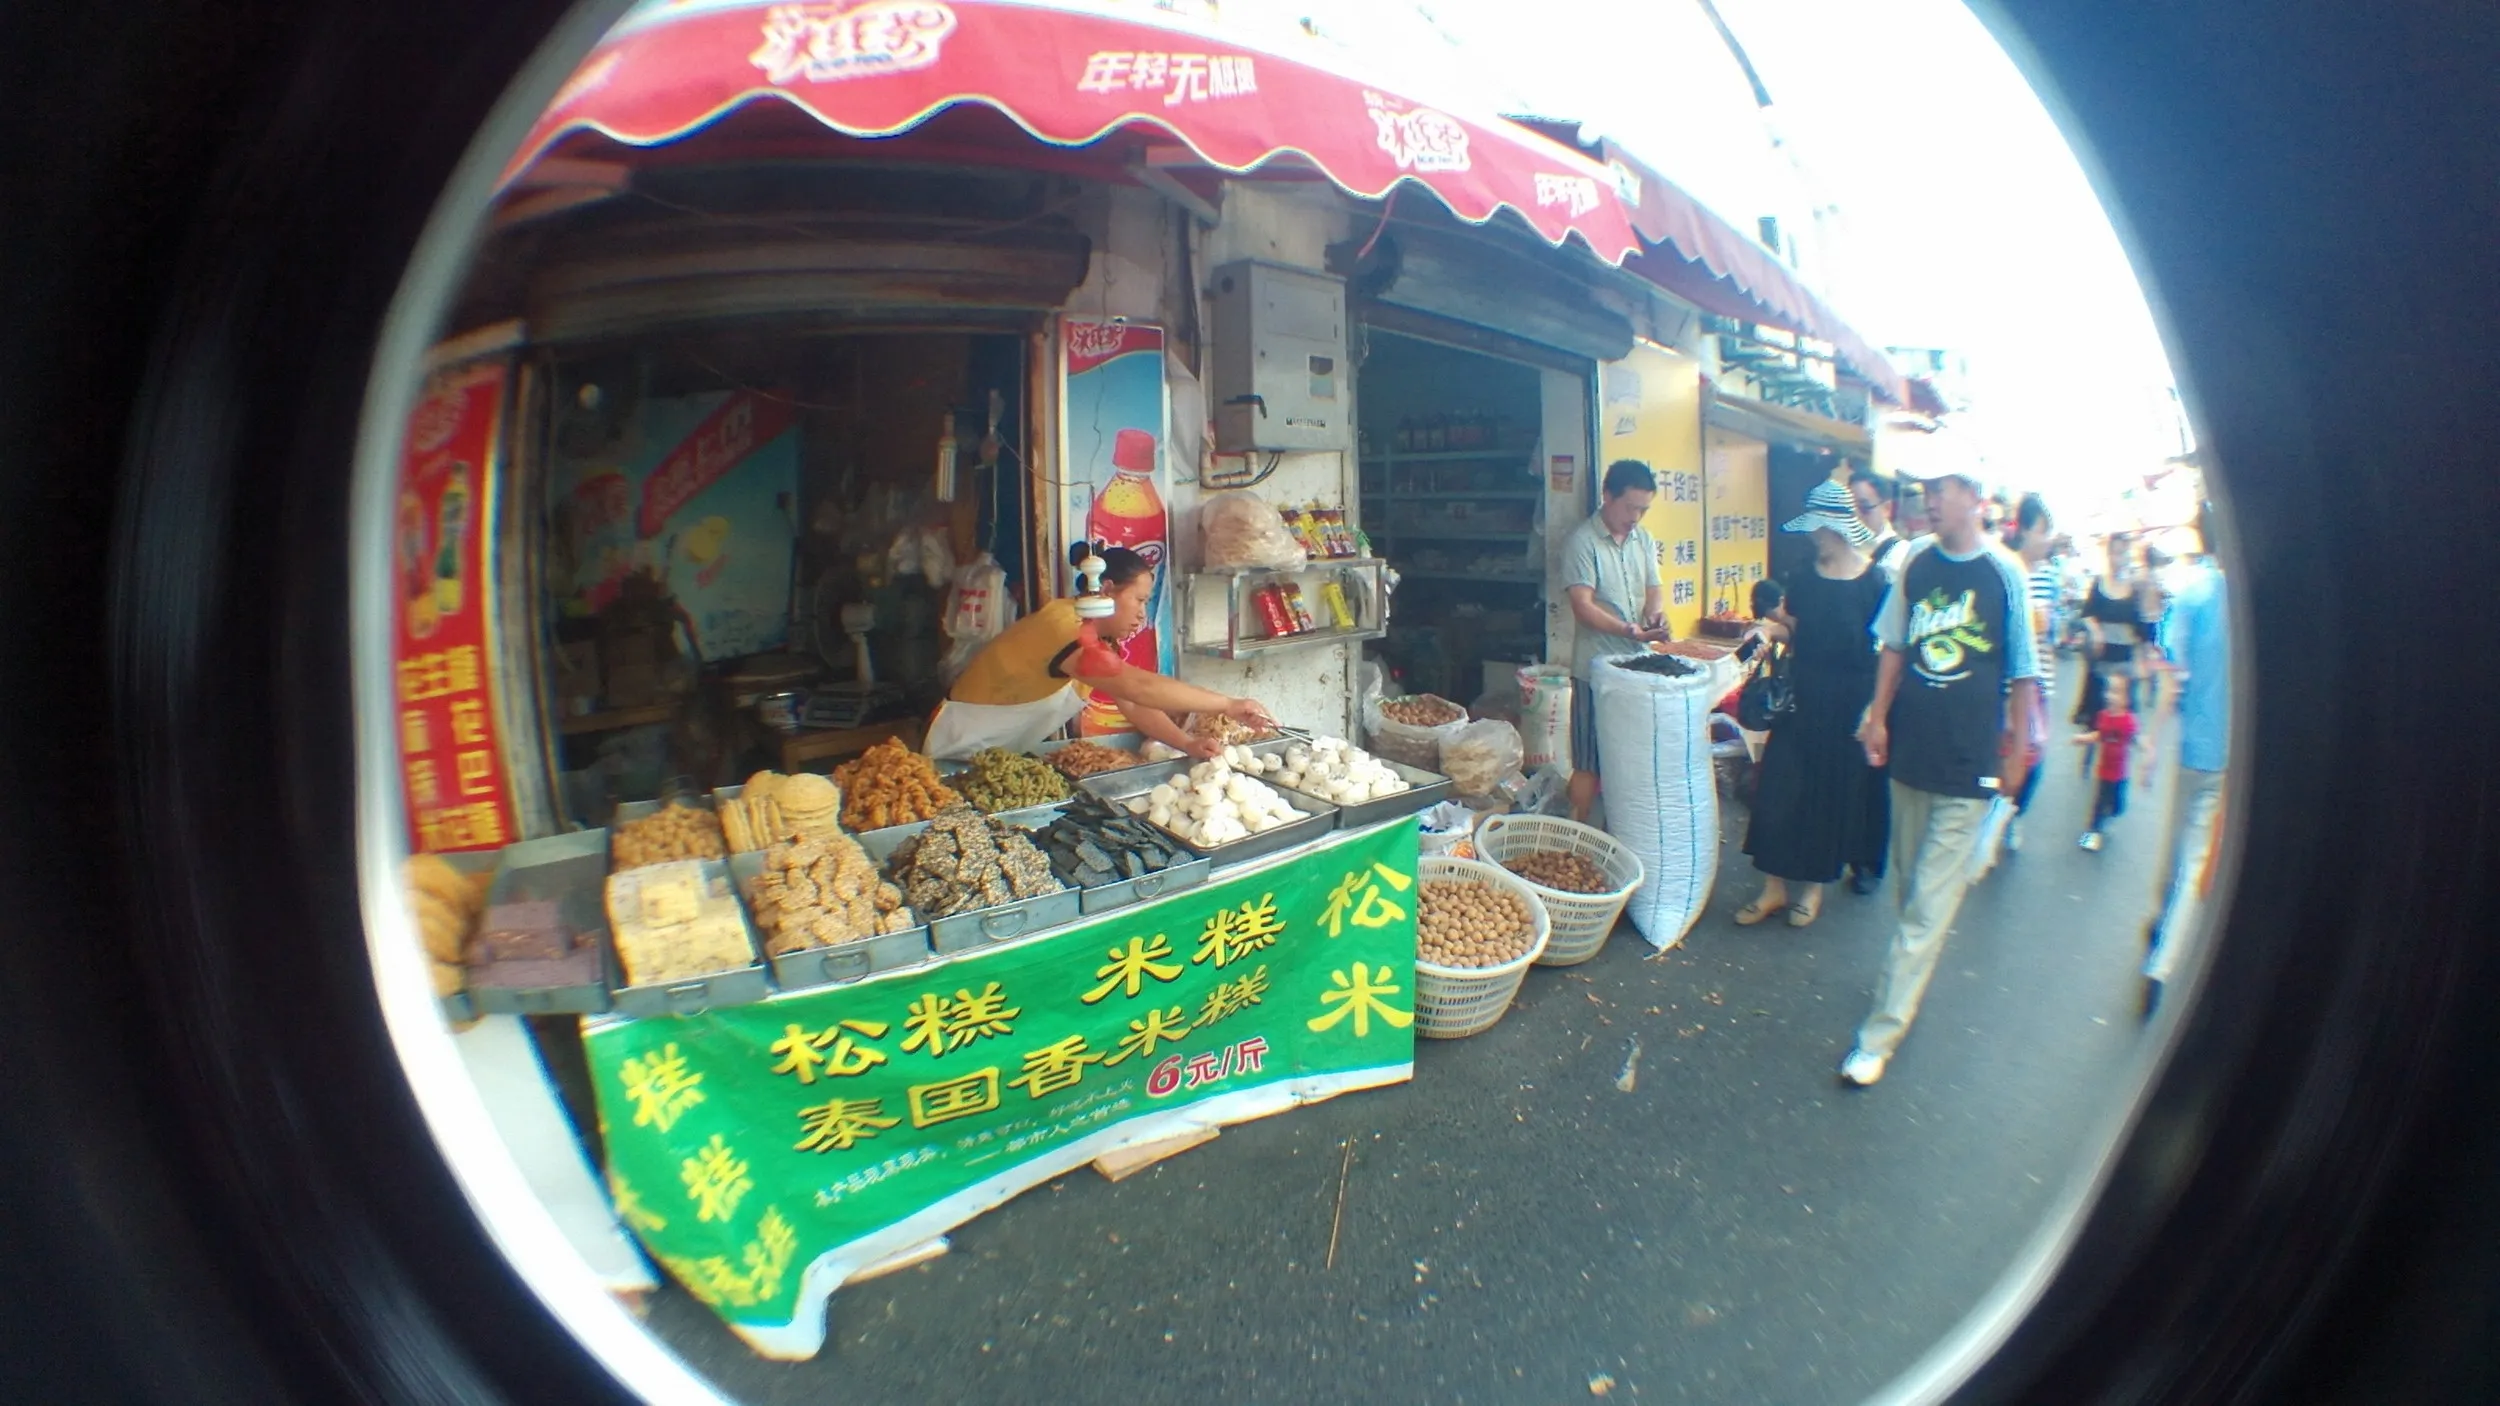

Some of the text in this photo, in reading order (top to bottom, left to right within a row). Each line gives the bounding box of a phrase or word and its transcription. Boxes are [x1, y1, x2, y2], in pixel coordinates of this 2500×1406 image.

[794, 964, 1272, 1154] 泰国香米糕
[1147, 1036, 1270, 1097] 6元/斤
